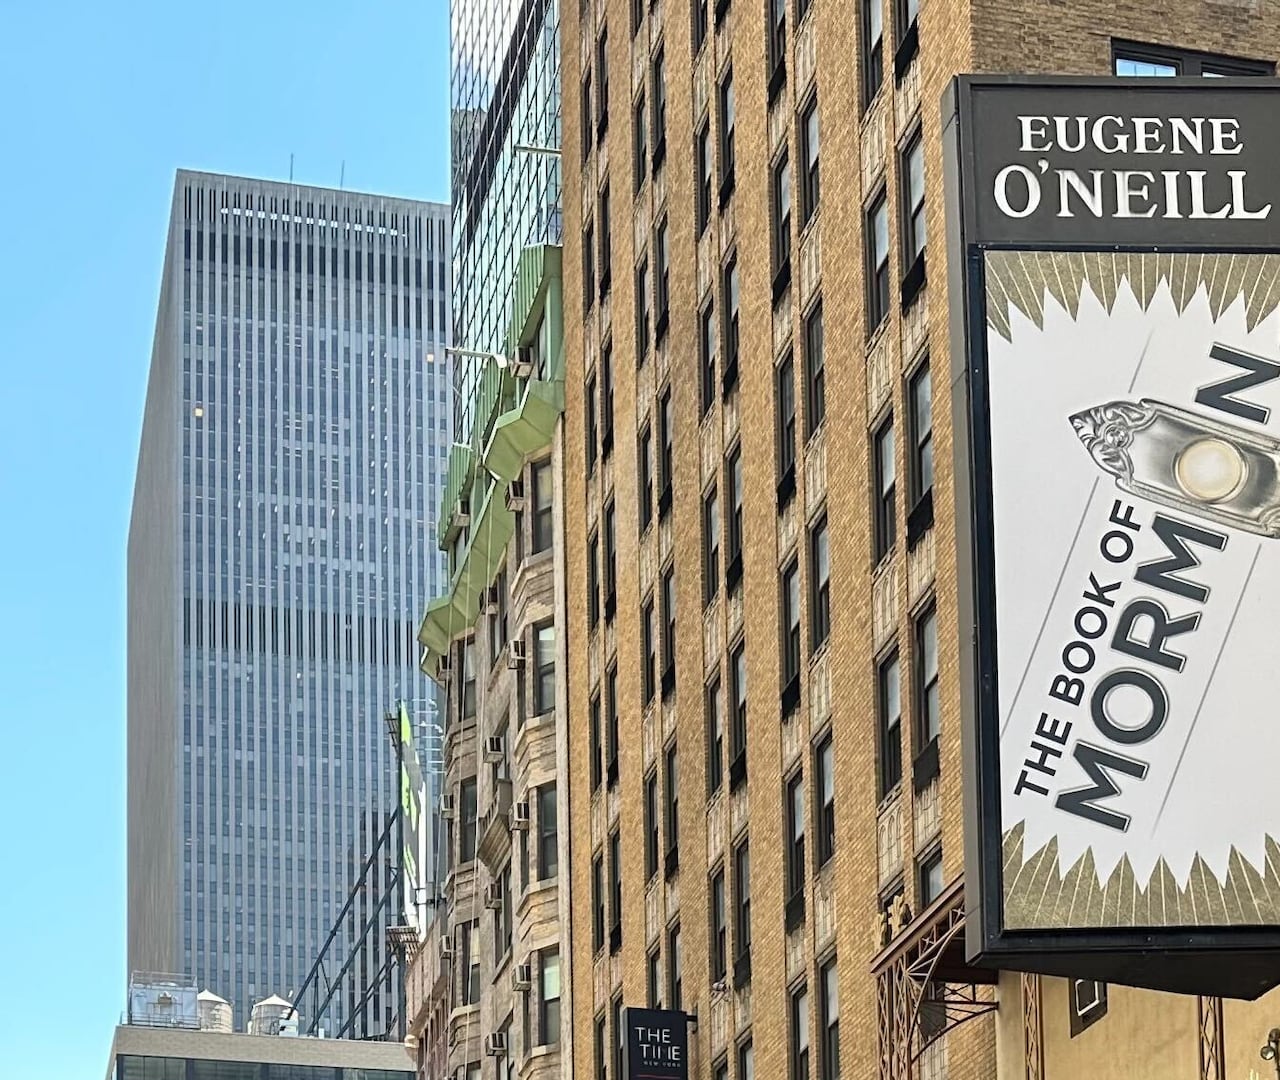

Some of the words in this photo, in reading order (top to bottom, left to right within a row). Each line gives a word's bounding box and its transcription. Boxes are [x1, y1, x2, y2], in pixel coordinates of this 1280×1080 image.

[1018, 115, 1244, 155] EUGENE
[993, 158, 1272, 219] O’NEILL
[1014, 712, 1073, 797] THE
[1049, 571, 1121, 706] BOOK
[1100, 499, 1141, 563] OF
[635, 1027, 671, 1043] THE
